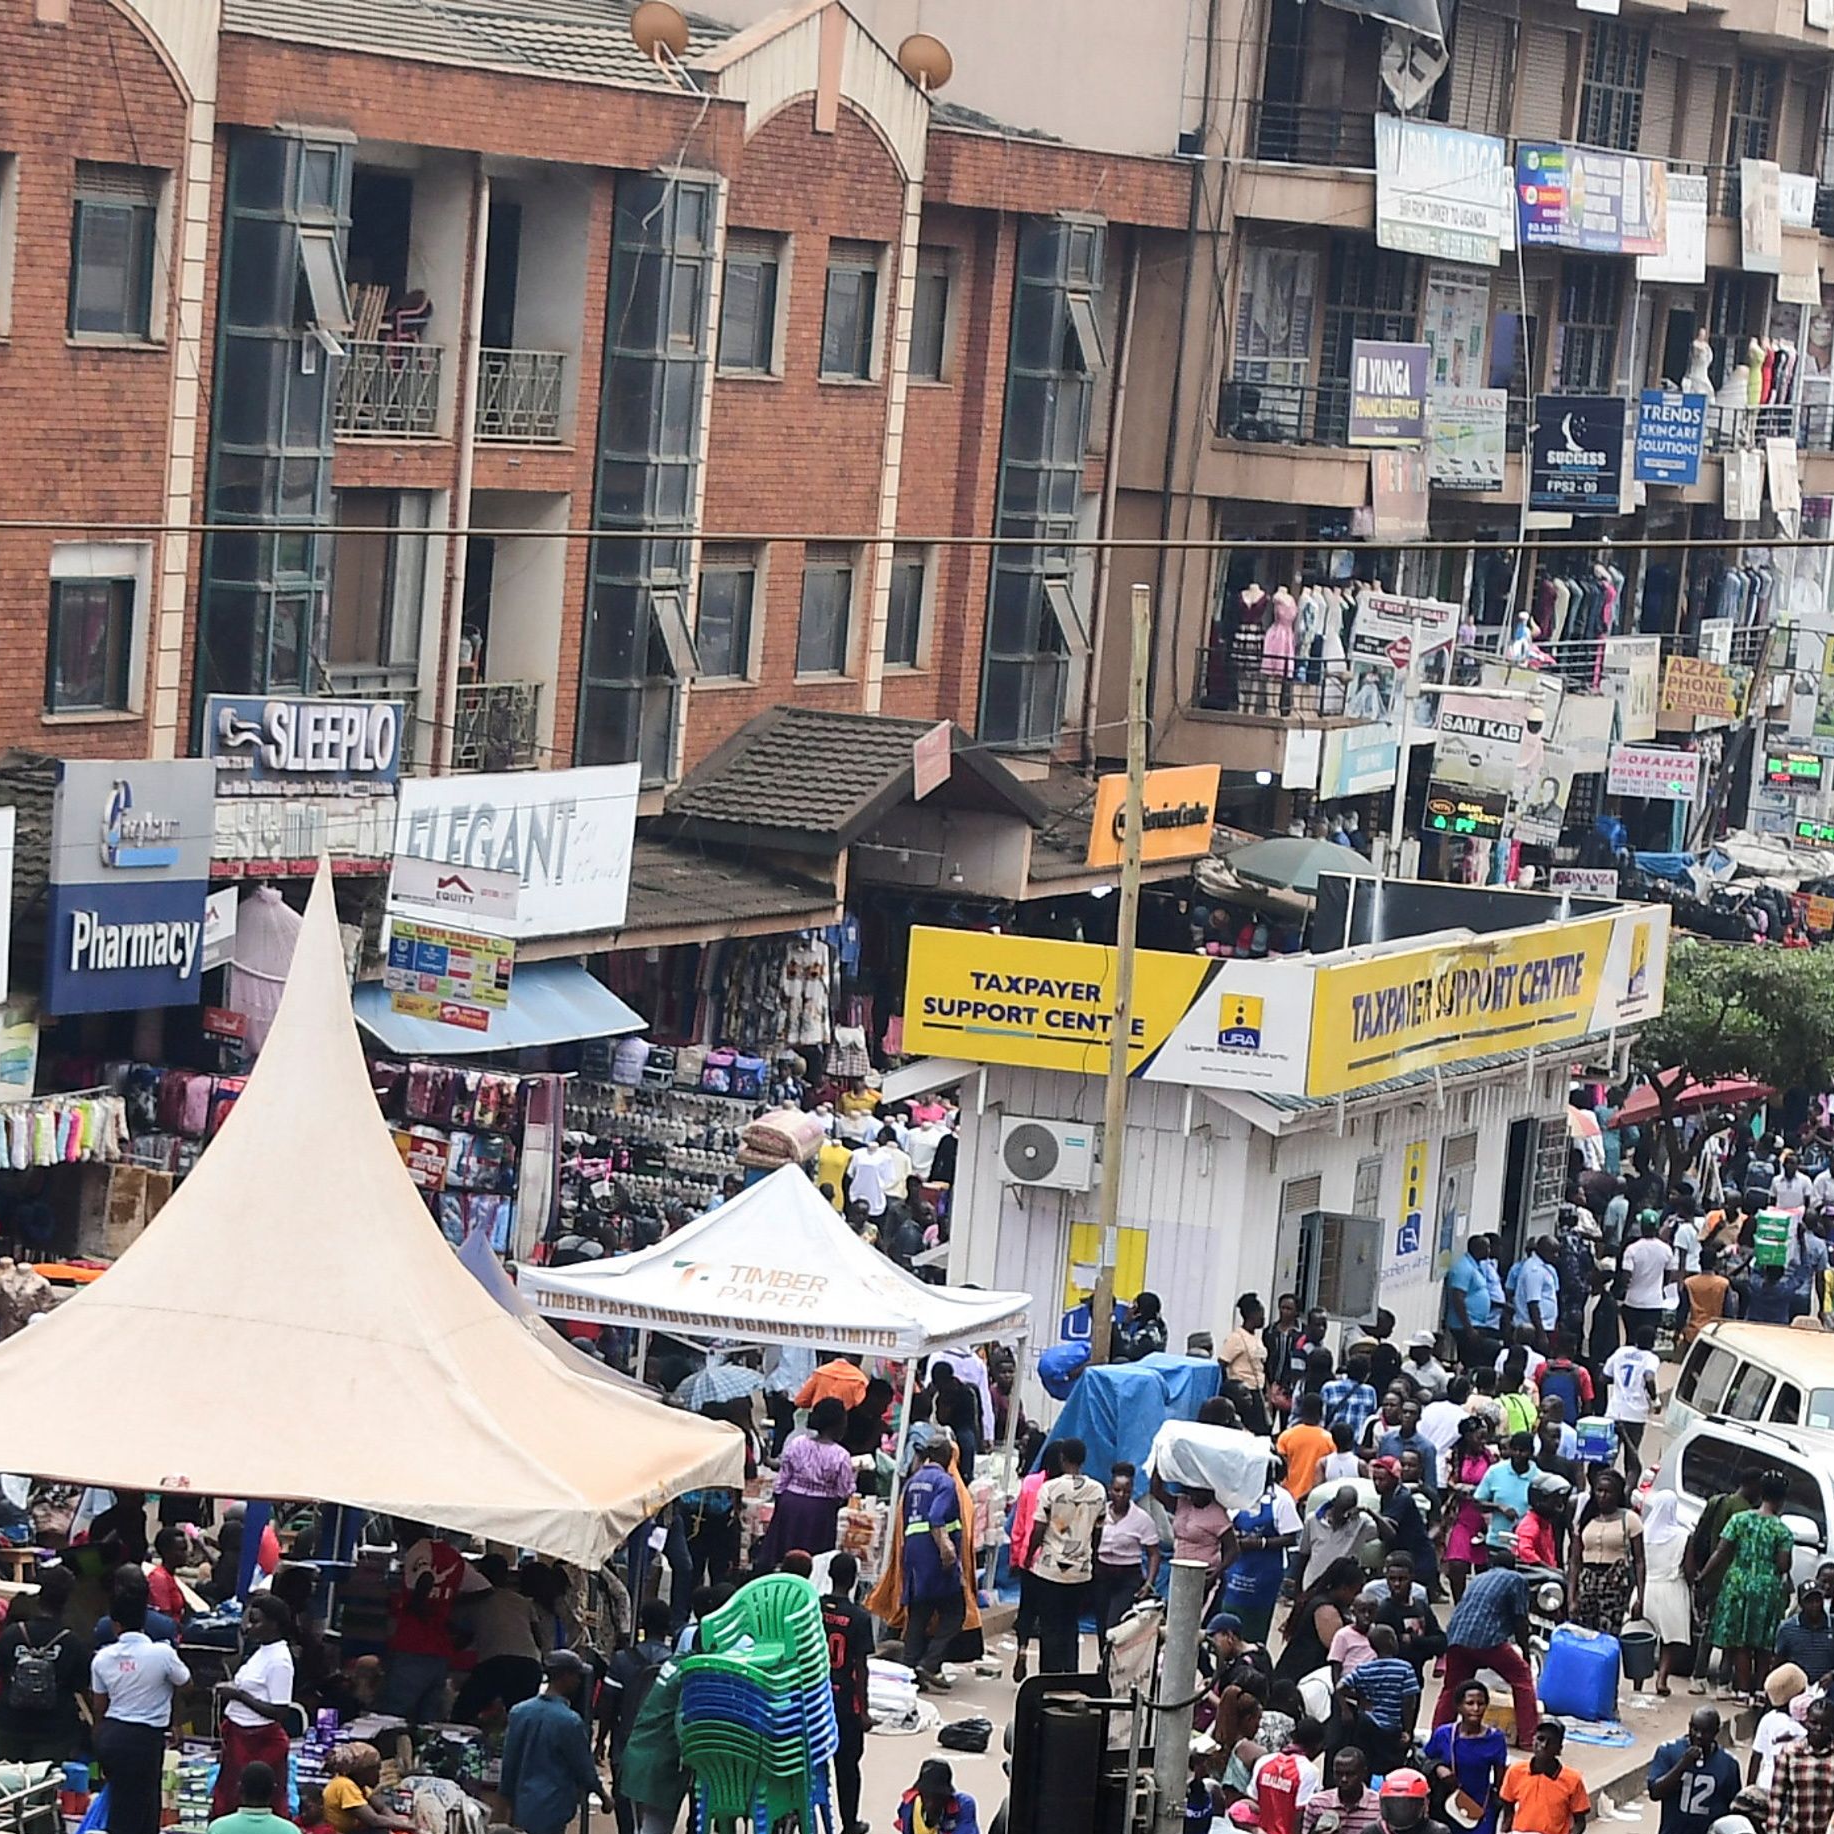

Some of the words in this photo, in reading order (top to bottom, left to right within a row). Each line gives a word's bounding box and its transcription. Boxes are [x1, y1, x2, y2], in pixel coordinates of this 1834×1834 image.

[1643, 404, 1702, 425] TRENDS
[1547, 449, 1607, 466] SUCCESS
[1637, 438, 1699, 456] SOLUTIONS
[1669, 659, 1720, 678] AZIZ
[1668, 676, 1728, 696] PHONE
[1665, 692, 1727, 711] REPAIR
[261, 702, 397, 771] SLEEPLO
[1442, 712, 1479, 737] SAM
[1482, 717, 1523, 743] KAB
[436, 890, 476, 905] EQUITY
[70, 908, 201, 979] Pharmacy
[970, 970, 1102, 1003] TAXPAYER
[1352, 976, 1434, 1043] TAXPAYER
[1435, 963, 1519, 1018] SUPPORT
[1518, 951, 1586, 1007] CENTRE
[923, 996, 1039, 1026] SUPPORT
[1044, 1008, 1145, 1037] CENTE
[1222, 1030, 1257, 1049] URA
[729, 1264, 829, 1294] TIMBER
[716, 1286, 819, 1309] PAPER
[535, 1289, 596, 1314] TIMBER
[598, 1298, 649, 1320] PAPER
[651, 1304, 730, 1330] INDUSTRY
[734, 1316, 801, 1338] UGANDA
[803, 1322, 832, 1342] CO.
[834, 1326, 897, 1349] LIMITED
[1680, 1770, 1718, 1815] 12
